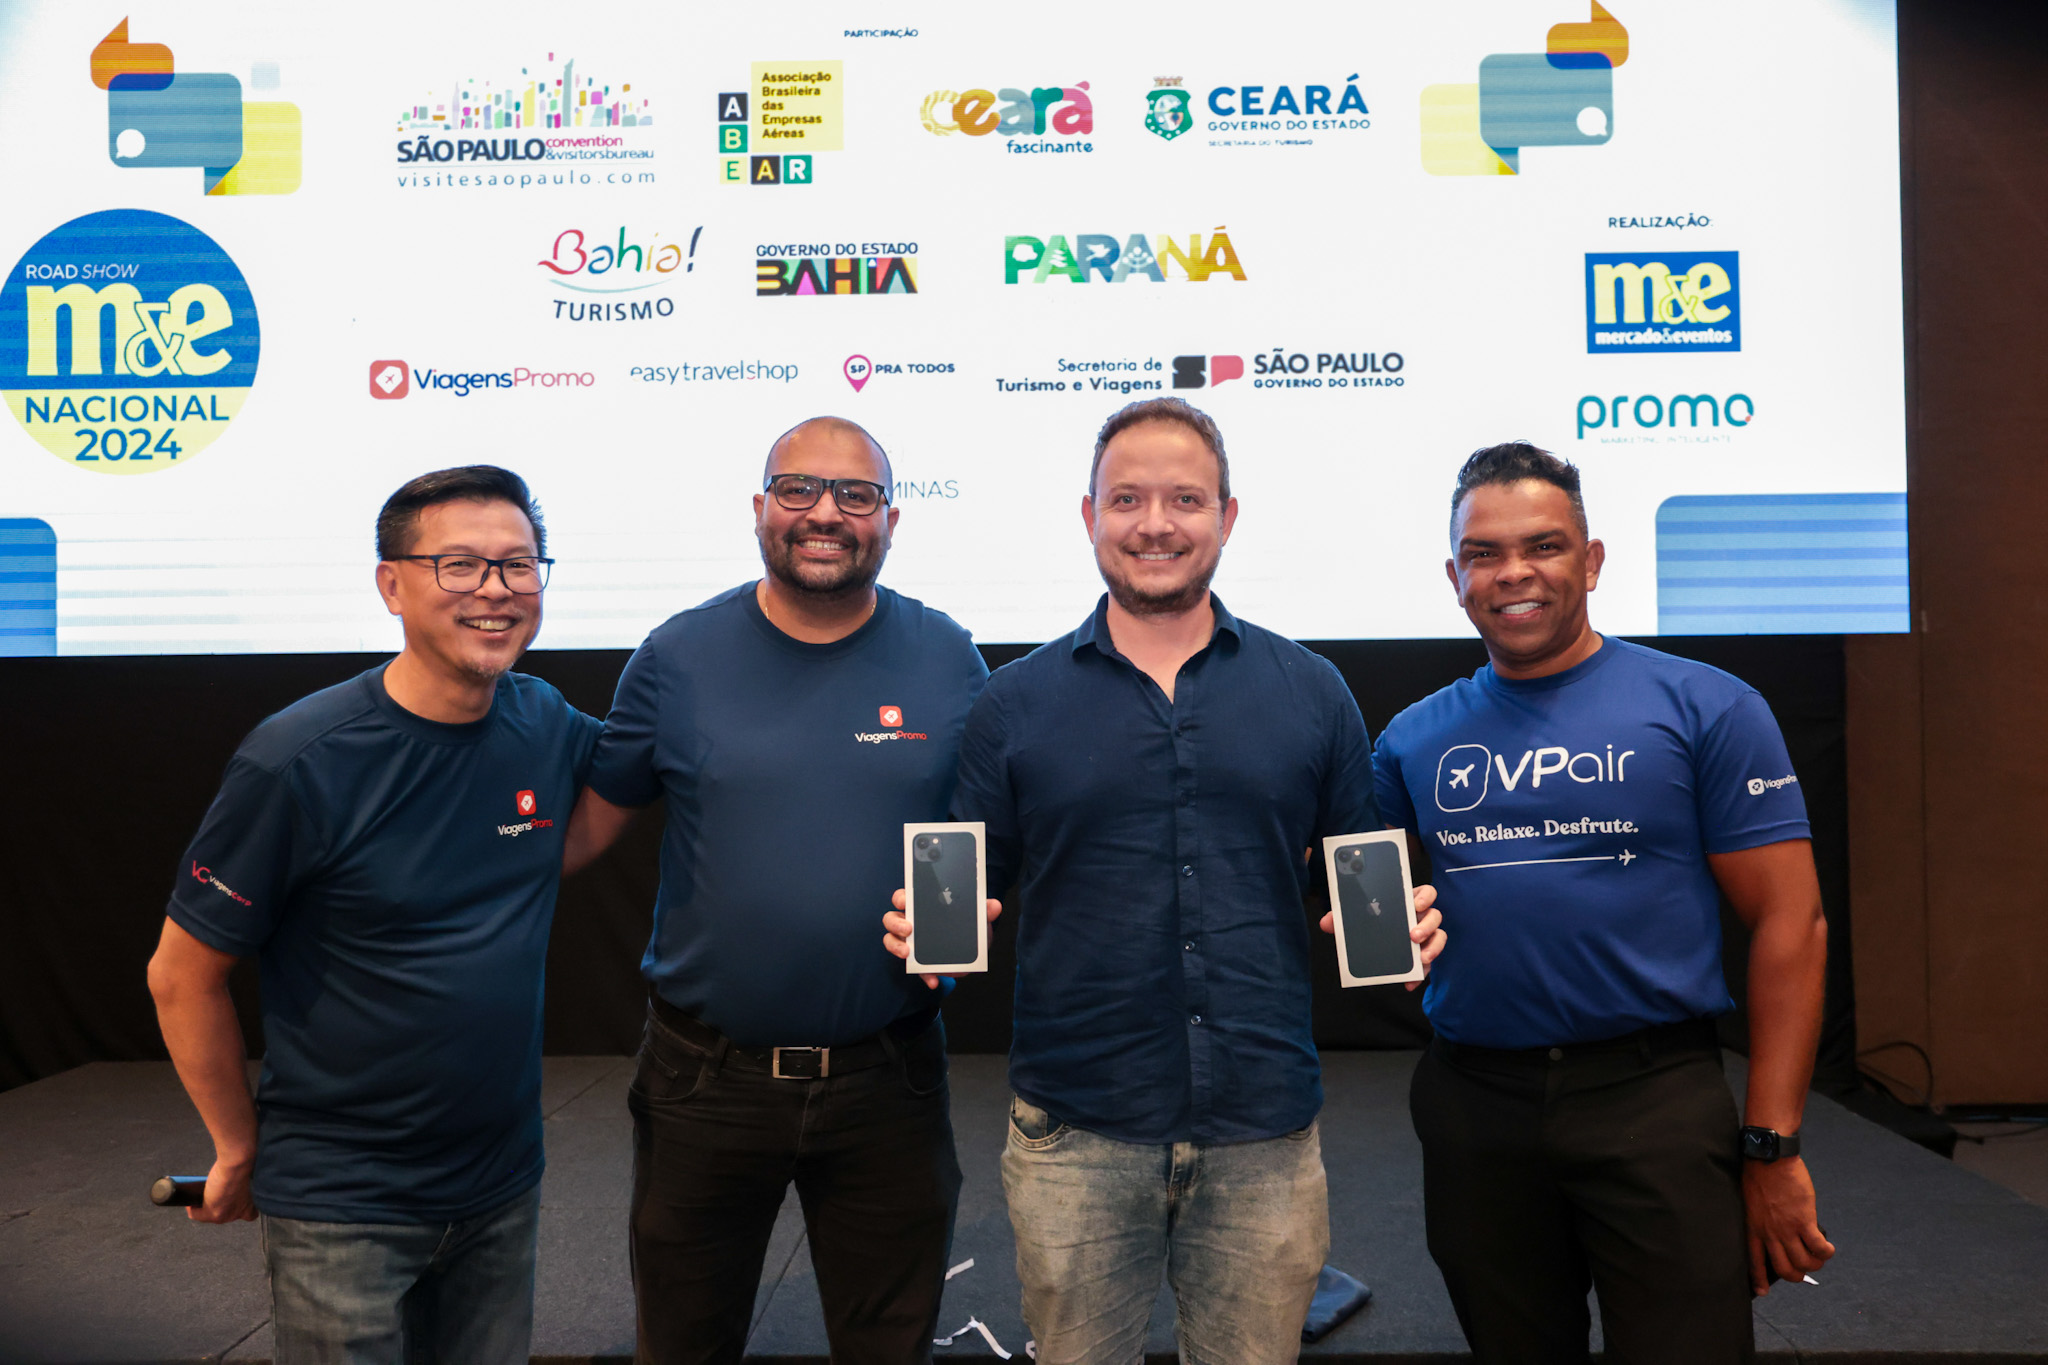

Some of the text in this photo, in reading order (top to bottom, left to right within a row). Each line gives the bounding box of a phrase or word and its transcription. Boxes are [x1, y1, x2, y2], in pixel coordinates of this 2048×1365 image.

[844, 27, 919, 39] PARTICIPAÇÃO
[761, 71, 832, 84] Associação
[762, 85, 821, 97] Brasileira
[1208, 73, 1369, 117] CEARÁ
[762, 100, 784, 111] das
[762, 113, 822, 126] Empresas
[1208, 119, 1371, 131] GOVERNO DO ESTADO
[762, 127, 805, 139] Aéreas
[397, 135, 546, 162] SÃO PAULO
[546, 135, 623, 149] convention
[1007, 139, 1094, 154] fascinante
[756, 242, 919, 257] GOVERNO DO ESTADO
[1004, 225, 1249, 285] PARANÁ
[26, 263, 140, 279] ROAD SHOW
[1593, 261, 1732, 325] m&e
[553, 297, 675, 321] TURISMO
[26, 282, 234, 377] m&e
[850, 364, 866, 374] SP
[875, 363, 955, 374] PRA TODOS
[1057, 356, 1163, 373] Secretaria de
[1253, 347, 1405, 375] SÃO PAULO
[629, 359, 799, 386] easytravelshop
[413, 366, 596, 398] ViagensPromo
[996, 376, 1163, 394] Turismo e Viagens
[1253, 377, 1405, 389] GOVERNO DO ESTADO
[25, 394, 230, 424] NACIONAL
[1576, 393, 1754, 440] promo
[74, 427, 183, 461] 2024
[854, 730, 928, 745] ViagensPromo
[1436, 816, 1640, 847] Voe. Relaxe. Desfrute.
